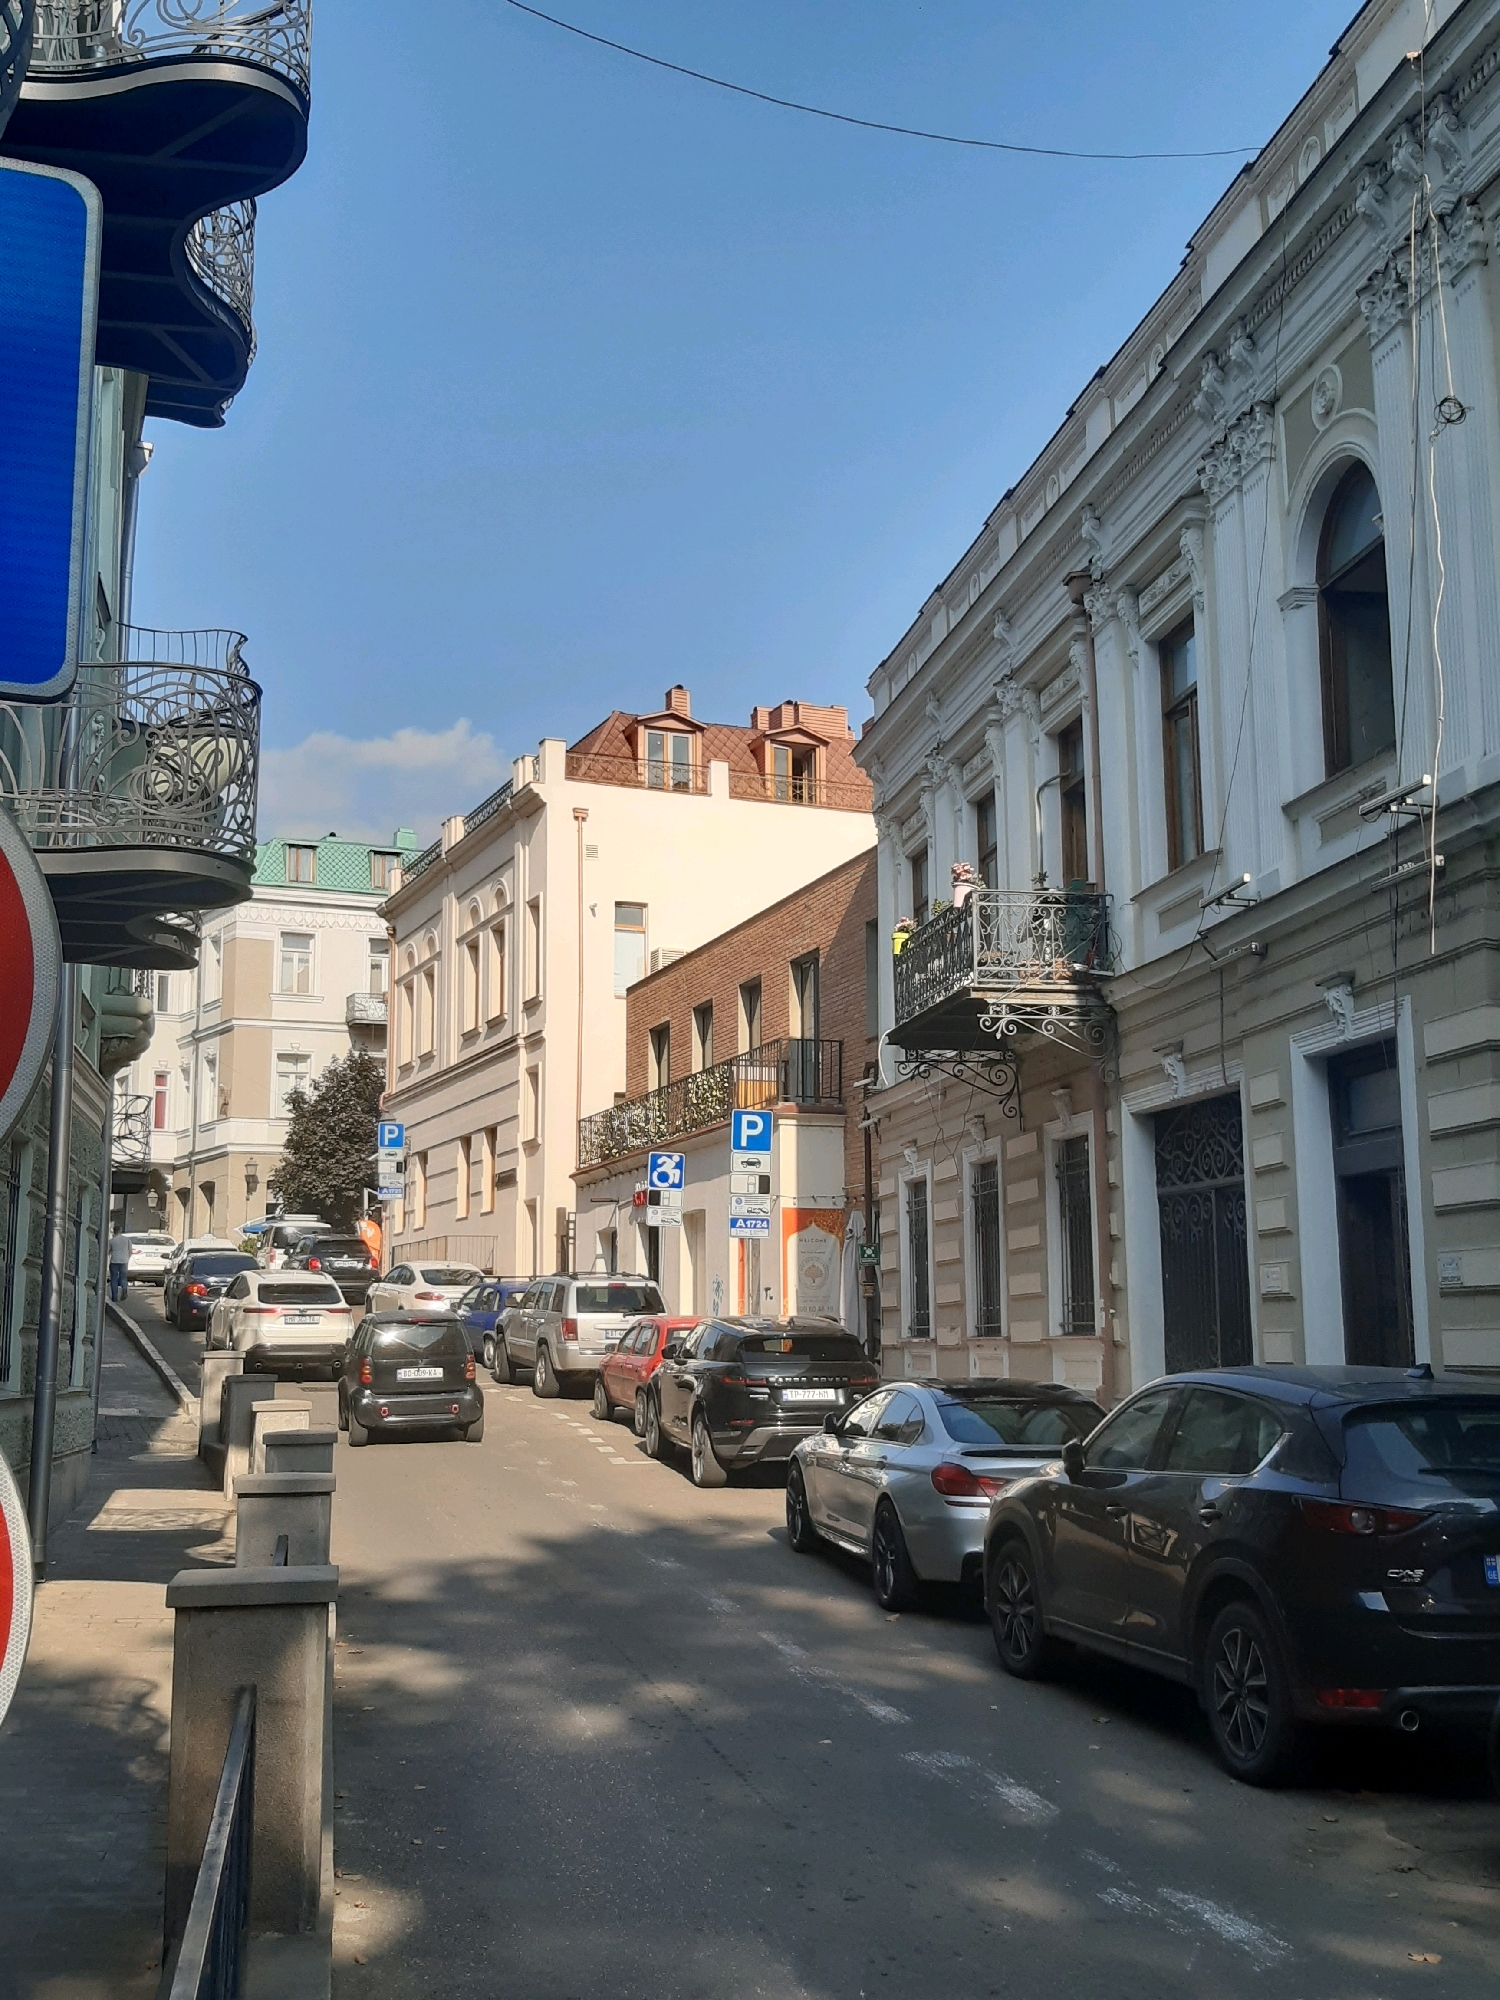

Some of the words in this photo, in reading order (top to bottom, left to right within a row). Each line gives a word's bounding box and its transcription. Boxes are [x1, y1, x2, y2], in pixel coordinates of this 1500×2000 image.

[384, 1124, 399, 1146] P
[741, 1114, 764, 1147] P
[1487, 1570, 1498, 1580] GE
